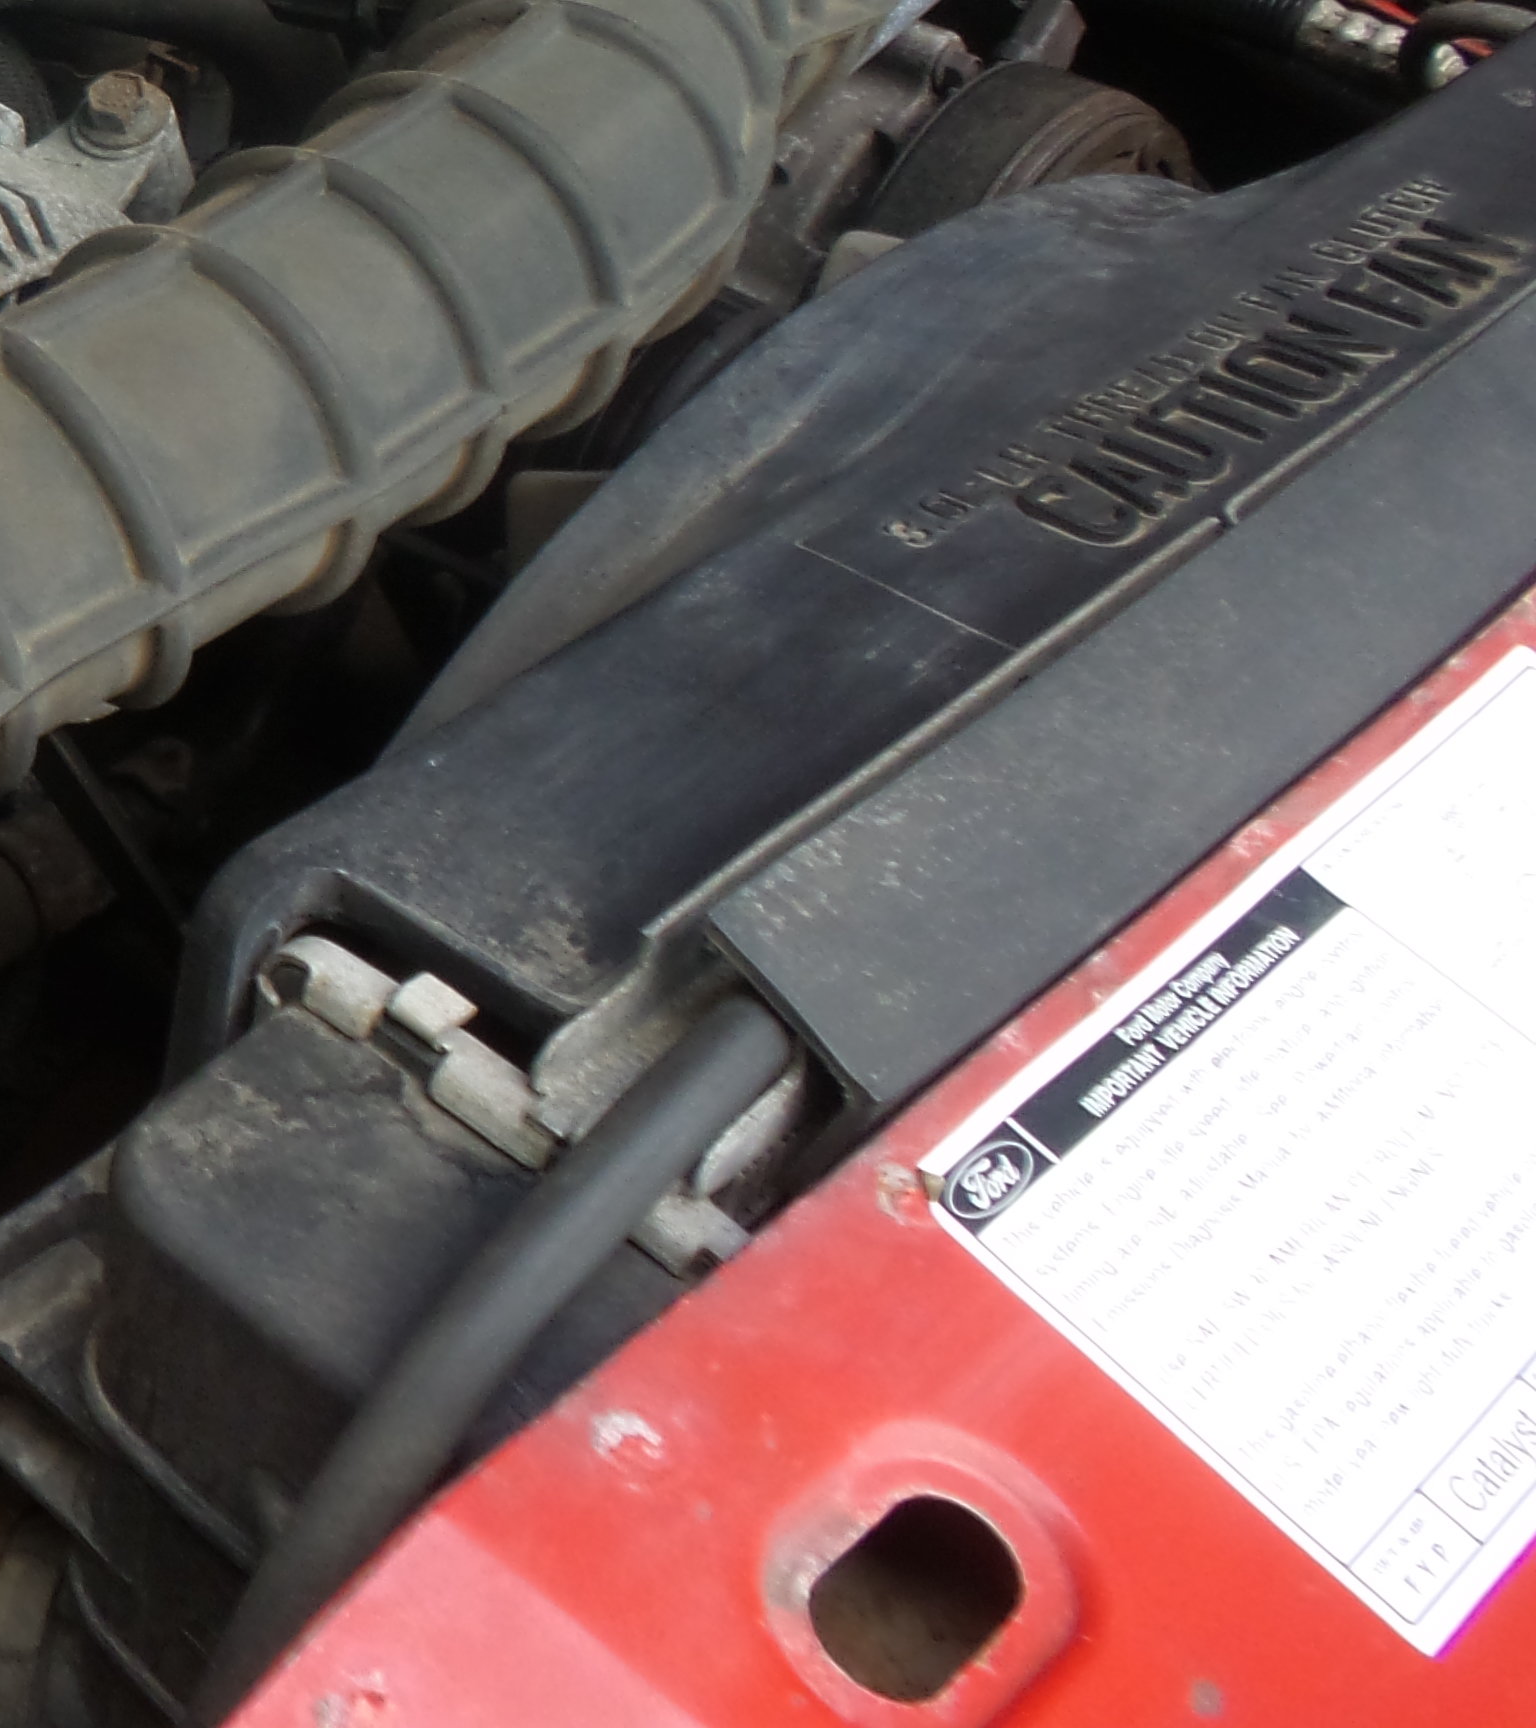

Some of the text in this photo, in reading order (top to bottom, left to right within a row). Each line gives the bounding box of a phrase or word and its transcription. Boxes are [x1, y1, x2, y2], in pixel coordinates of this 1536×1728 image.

[1013, 216, 1528, 549] CAUTION FAN
[1080, 922, 1302, 1120] IMPORTANT VEHICLE INFORMATION
[956, 1150, 1024, 1214] Ford
